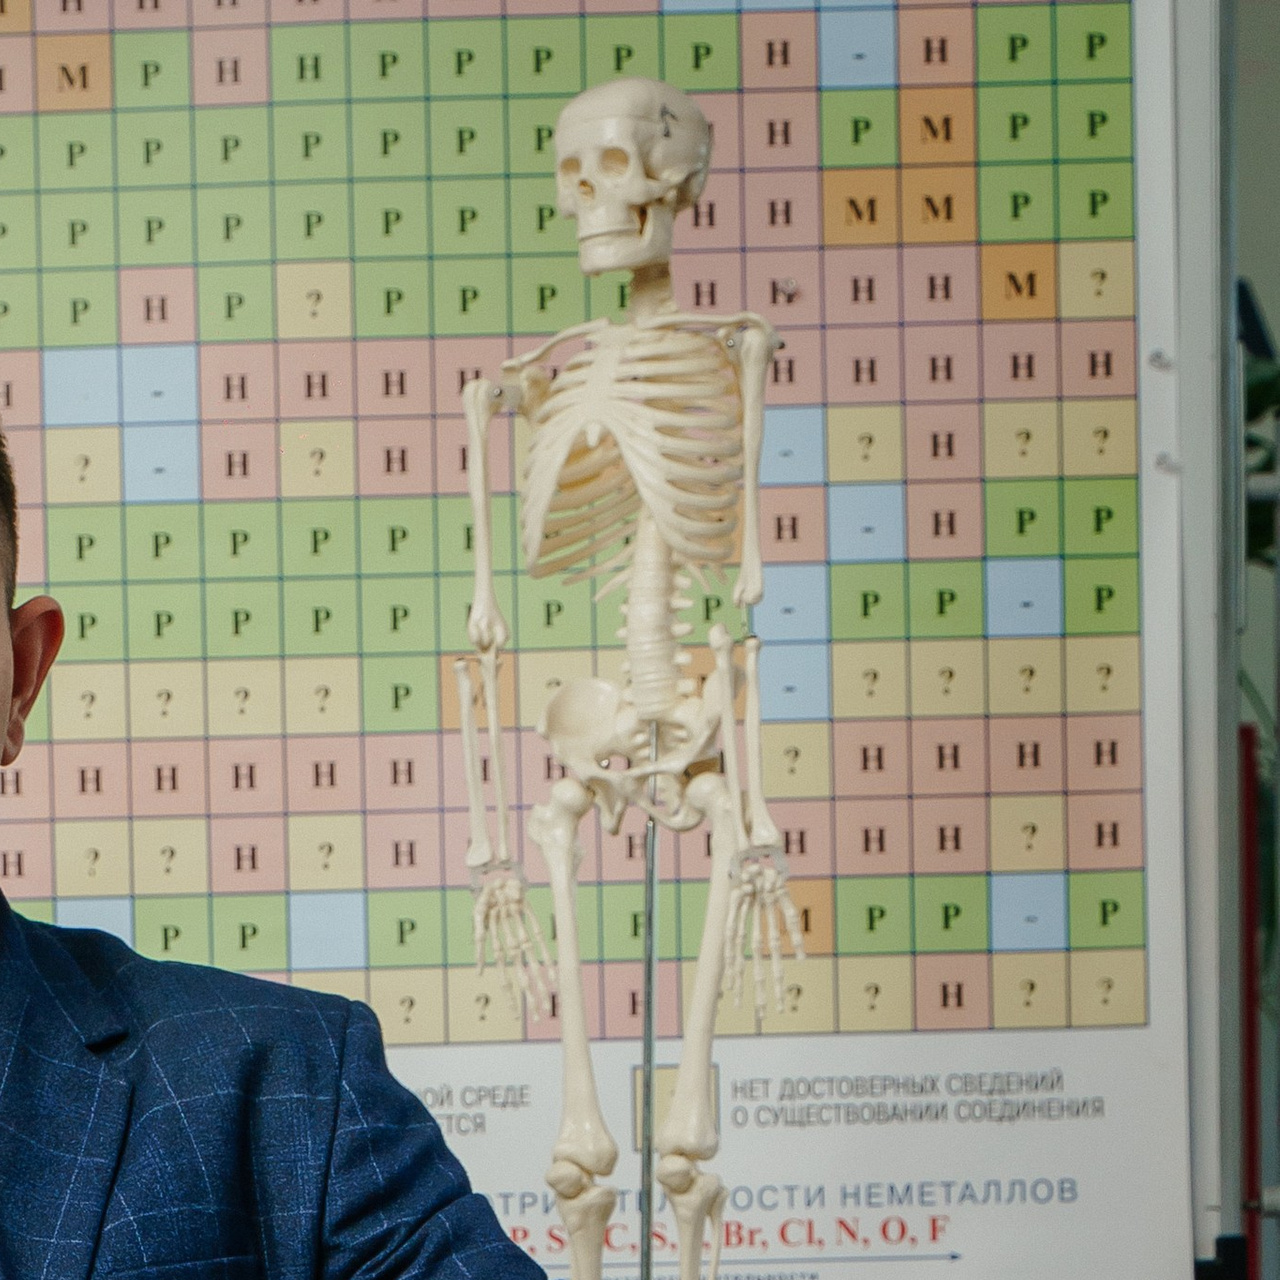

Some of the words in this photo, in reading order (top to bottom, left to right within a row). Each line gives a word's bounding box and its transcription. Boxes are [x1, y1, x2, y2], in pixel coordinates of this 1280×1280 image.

[59, 64, 88, 90] М
[142, 62, 161, 88] Р
[217, 58, 240, 85] Н
[297, 54, 321, 82] Н
[379, 52, 399, 79] Р
[455, 49, 475, 77] Р
[533, 47, 553, 75] Р
[614, 45, 634, 73] Р
[692, 43, 712, 71] Р
[766, 40, 790, 68] Н
[923, 37, 948, 65] Н
[1008, 34, 1029, 63] Р
[1086, 32, 1107, 61] Р
[69, 220, 88, 247] Р
[145, 218, 165, 244] Р
[224, 215, 242, 241] Р
[304, 211, 323, 238] Р
[383, 209, 402, 236] Р
[458, 207, 478, 235] Р
[536, 205, 556, 233] Р
[693, 201, 716, 229] Н
[768, 199, 792, 227] Н
[847, 197, 877, 224] М
[923, 194, 953, 222] М
[1011, 192, 1031, 220] Р
[1089, 190, 1109, 218] Р
[71, 299, 90, 325] Р
[144, 296, 167, 323] Н
[225, 293, 244, 320] Р
[384, 289, 404, 316] Р
[460, 287, 479, 314] Р
[538, 285, 558, 312] Р
[694, 281, 717, 307] Н
[851, 276, 875, 304] Н
[928, 274, 952, 301] Н
[1006, 271, 1037, 299] М
[76, 535, 95, 561] Р
[152, 532, 172, 559] Р
[230, 530, 250, 557] Р
[311, 528, 331, 555] Р
[388, 526, 408, 554] Р
[775, 515, 799, 542] Н
[932, 510, 956, 537] Н
[1016, 508, 1037, 536] Р
[1093, 506, 1114, 534] Р
[0, 769, 23, 797] Н
[79, 767, 102, 794] Н
[155, 765, 178, 792] Н
[232, 763, 256, 790] Н
[313, 761, 336, 788] Н
[391, 759, 414, 786] Н
[861, 745, 884, 772] Н
[936, 743, 960, 771] Н
[1017, 741, 1041, 769] Н
[1094, 740, 1118, 767] Н
[1, 851, 24, 878] Н
[234, 845, 258, 872] Н
[393, 840, 416, 867] Н
[783, 829, 806, 856] Н
[862, 827, 886, 854] Н
[938, 825, 961, 852] Н
[1095, 821, 1119, 849] Н
[162, 925, 181, 951] Р
[239, 924, 258, 950] Р
[398, 919, 417, 946] Р
[866, 906, 886, 932] Р
[942, 904, 962, 931] Р
[1100, 900, 1120, 927] Р
[732, 1078, 770, 1101] НЕТ
[779, 1073, 939, 1101] ДОСТОВЕРНЫХ
[945, 1067, 1065, 1096] СВЕДЕНИЙ
[755, 1100, 948, 1128] СУЩЕСТВОВАНИИ
[954, 1096, 1105, 1123] СОЕДИНЕНИЯ
[842, 1179, 1079, 1208] НЕМЕТАЛЛОВ
[929, 1212, 952, 1242] F
